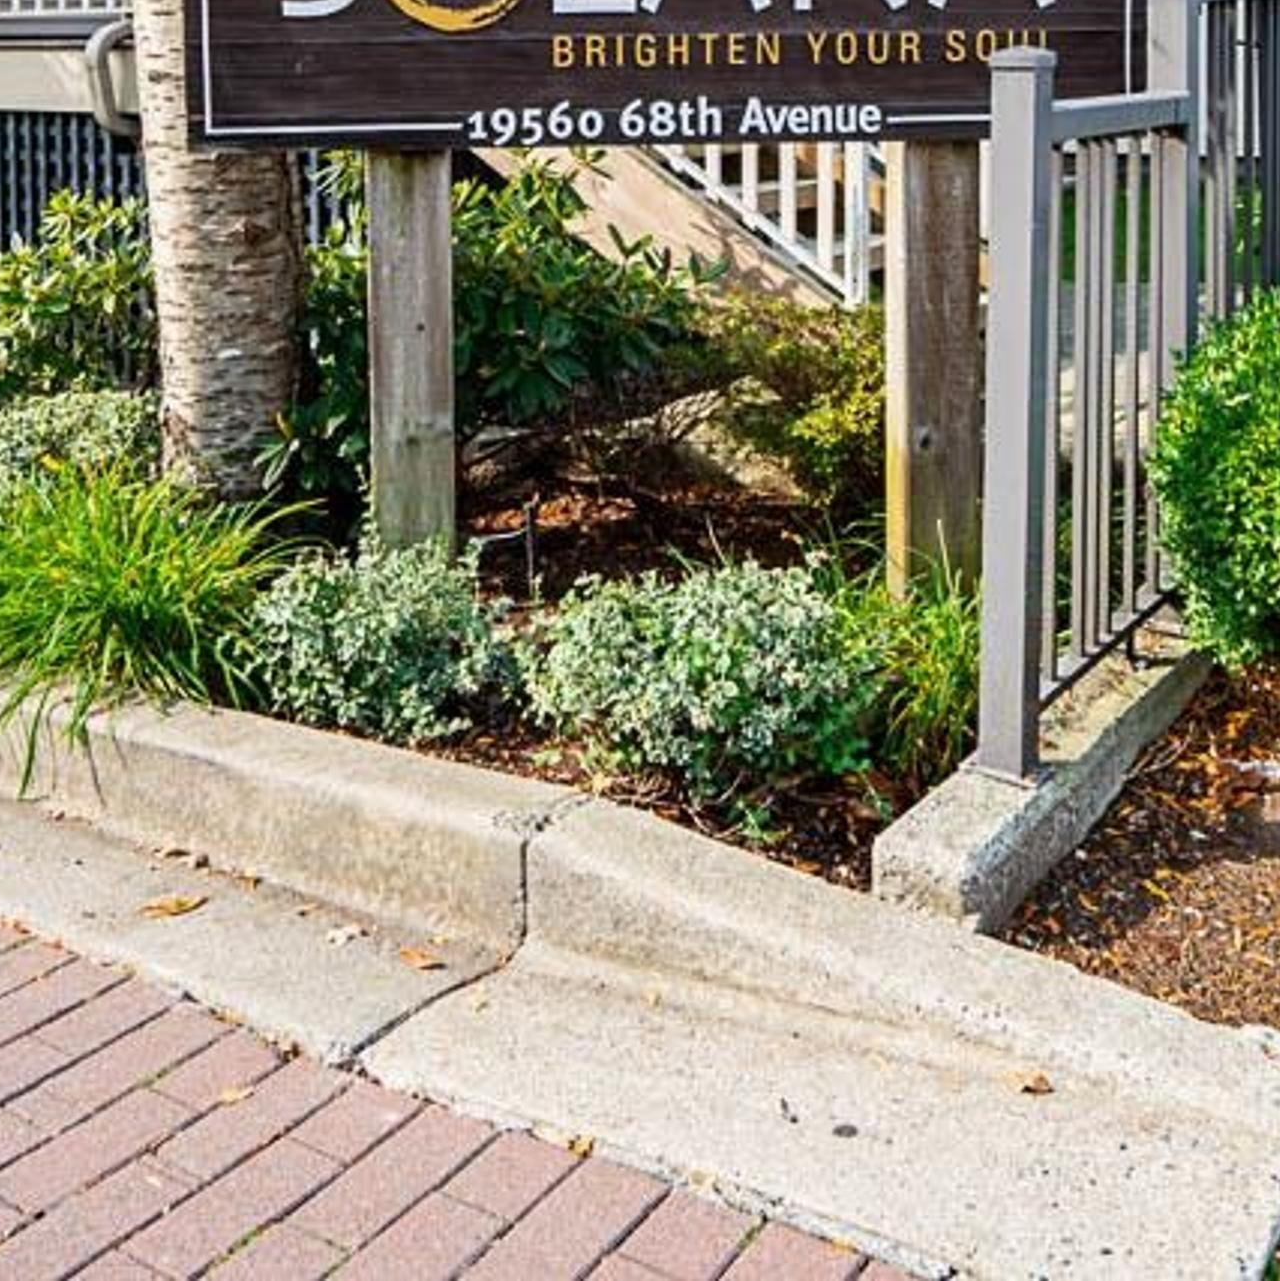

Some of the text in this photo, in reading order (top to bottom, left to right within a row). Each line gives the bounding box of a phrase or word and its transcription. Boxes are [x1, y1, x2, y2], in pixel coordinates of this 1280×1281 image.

[552, 33, 780, 67] BRIGHTEN
[807, 30, 921, 65] YOUR
[467, 96, 882, 145] 19560 68th Avenue
